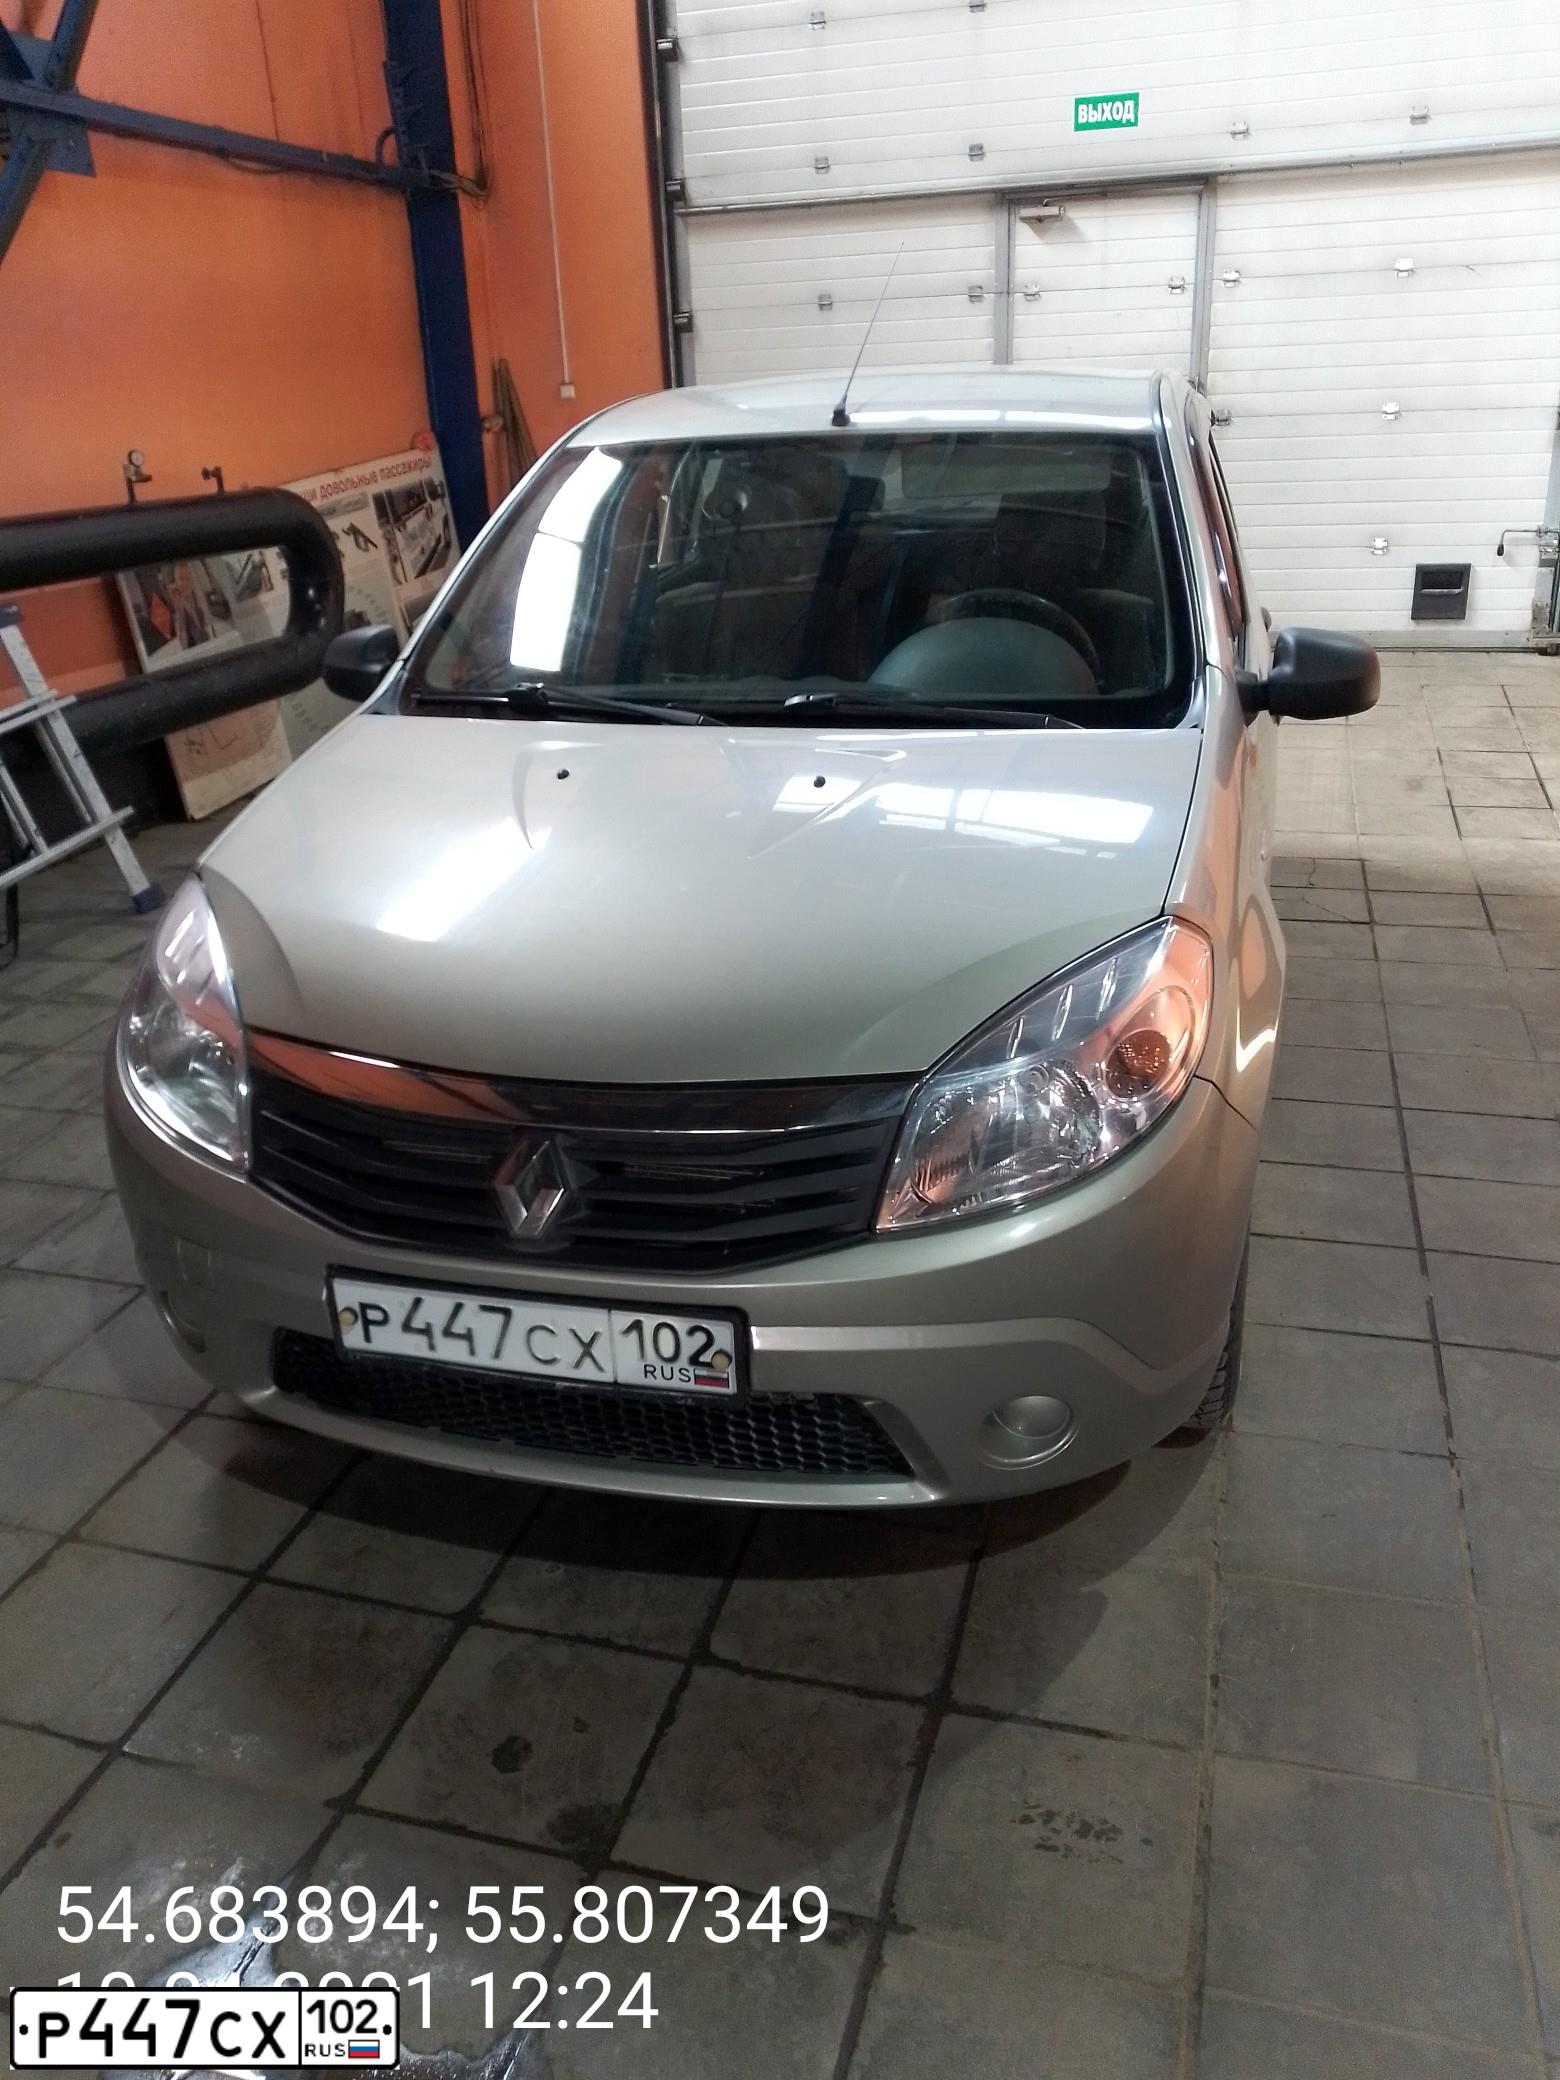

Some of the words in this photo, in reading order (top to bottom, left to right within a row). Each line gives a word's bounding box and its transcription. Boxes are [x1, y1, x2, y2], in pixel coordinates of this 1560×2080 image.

[1077, 99, 1135, 124] ВЫХОД
[621, 1317, 716, 1369] 102
[643, 1363, 692, 1385] RUS
